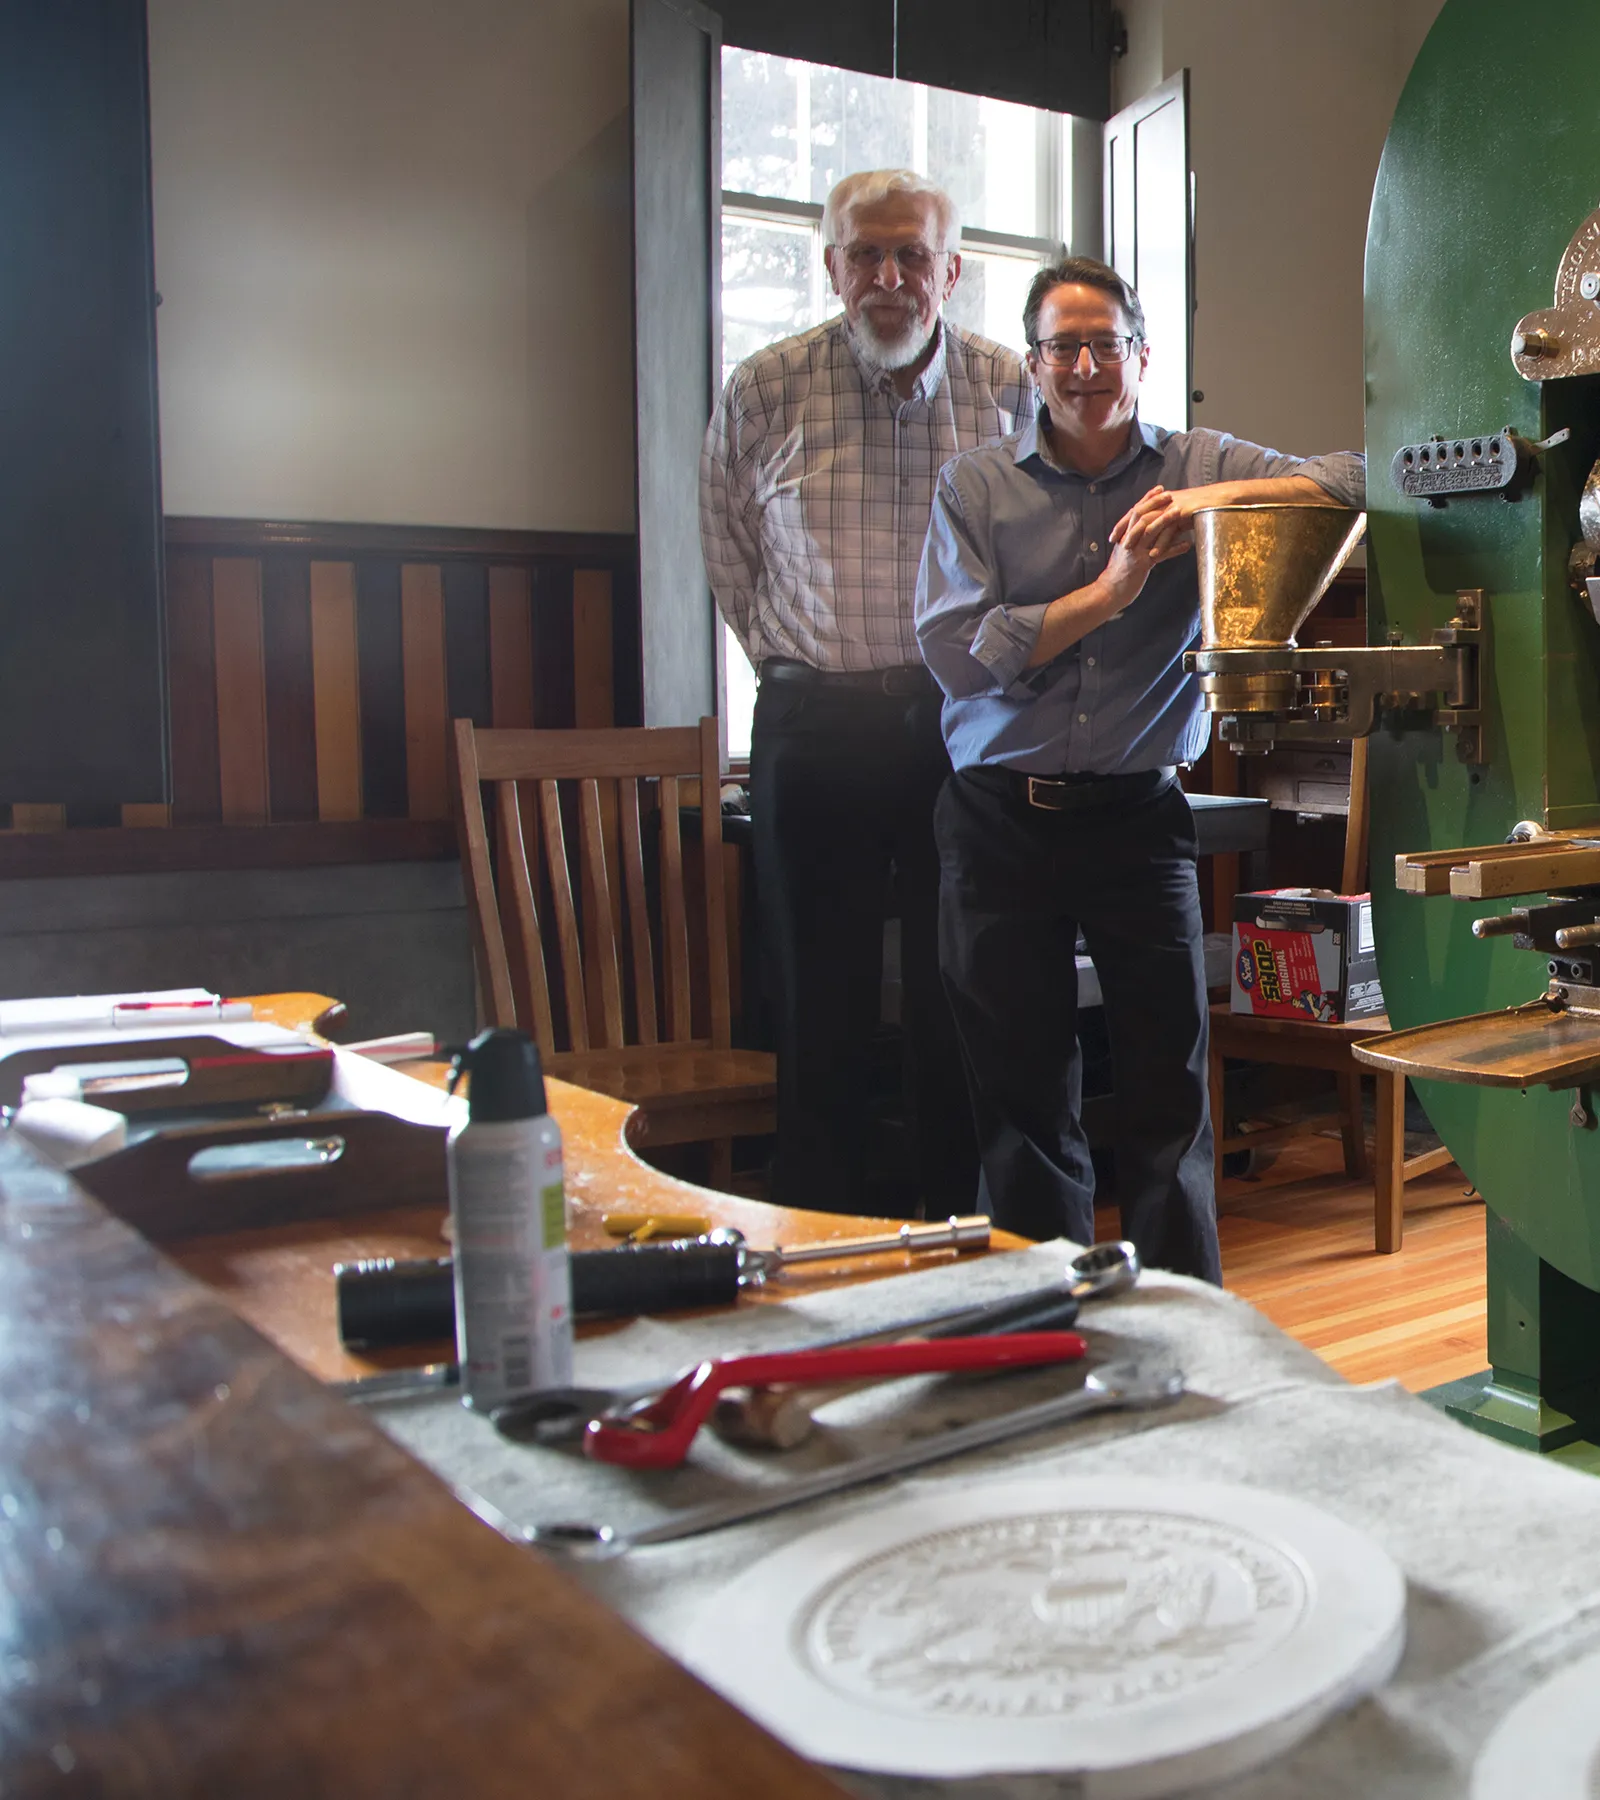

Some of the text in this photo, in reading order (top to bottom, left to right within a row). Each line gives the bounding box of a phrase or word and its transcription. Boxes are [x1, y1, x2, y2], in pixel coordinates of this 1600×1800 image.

[1241, 956, 1253, 983] Scott
[1253, 939, 1281, 1002] SHOP
[1275, 949, 1292, 996] ORIGINAL
